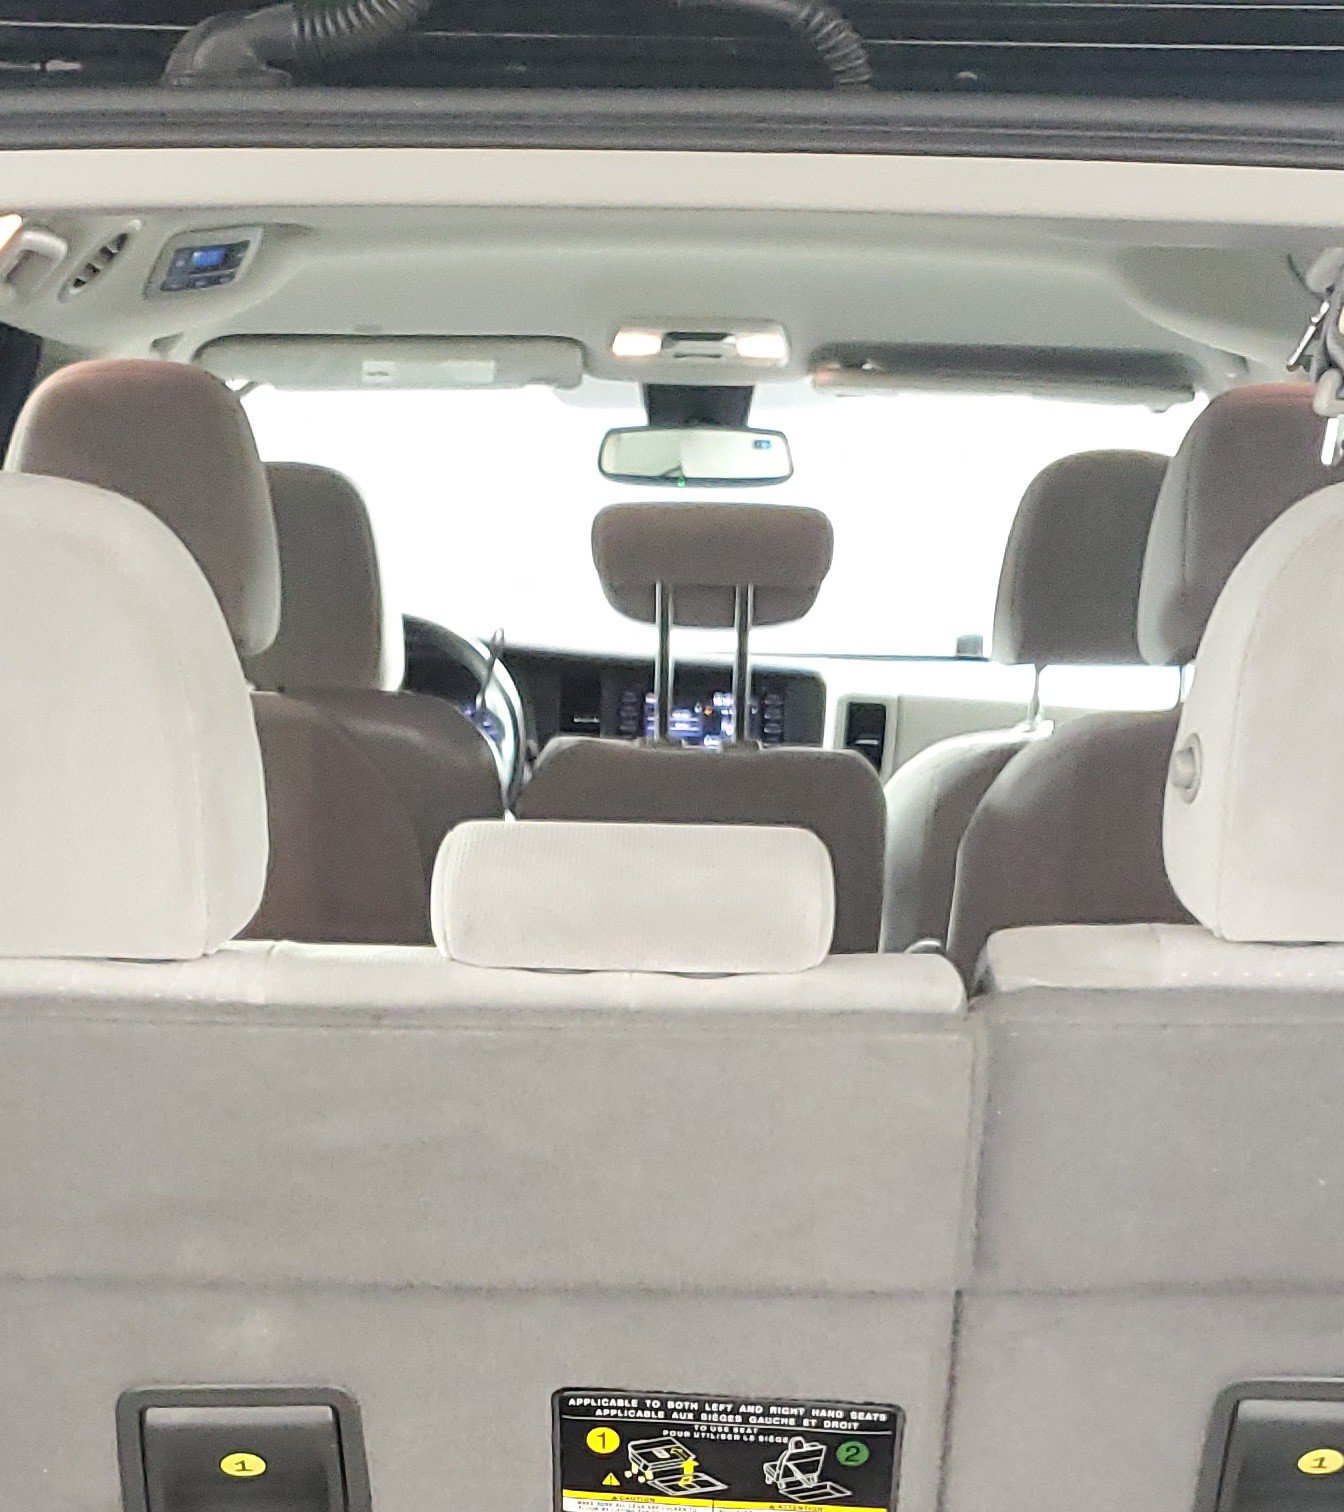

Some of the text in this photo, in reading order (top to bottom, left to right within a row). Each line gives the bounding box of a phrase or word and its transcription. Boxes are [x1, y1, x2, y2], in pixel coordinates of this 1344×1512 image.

[568, 1398, 887, 1422] APPLICABLE TO BOTH LEFT AND RIGHT HAND SEATS
[595, 1409, 665, 1418] APPLICABLE
[672, 1412, 694, 1420] AUX
[749, 1415, 795, 1426] GAUCHE
[803, 1418, 817, 1427] ET
[823, 1420, 859, 1430] DROIT
[663, 1430, 691, 1438] POUR
[709, 1425, 729, 1433] USE
[733, 1426, 758, 1434] SEAT
[596, 1431, 606, 1449] 1
[845, 1445, 861, 1462] 2
[235, 1460, 254, 1471] 1
[1310, 1457, 1327, 1468] 1
